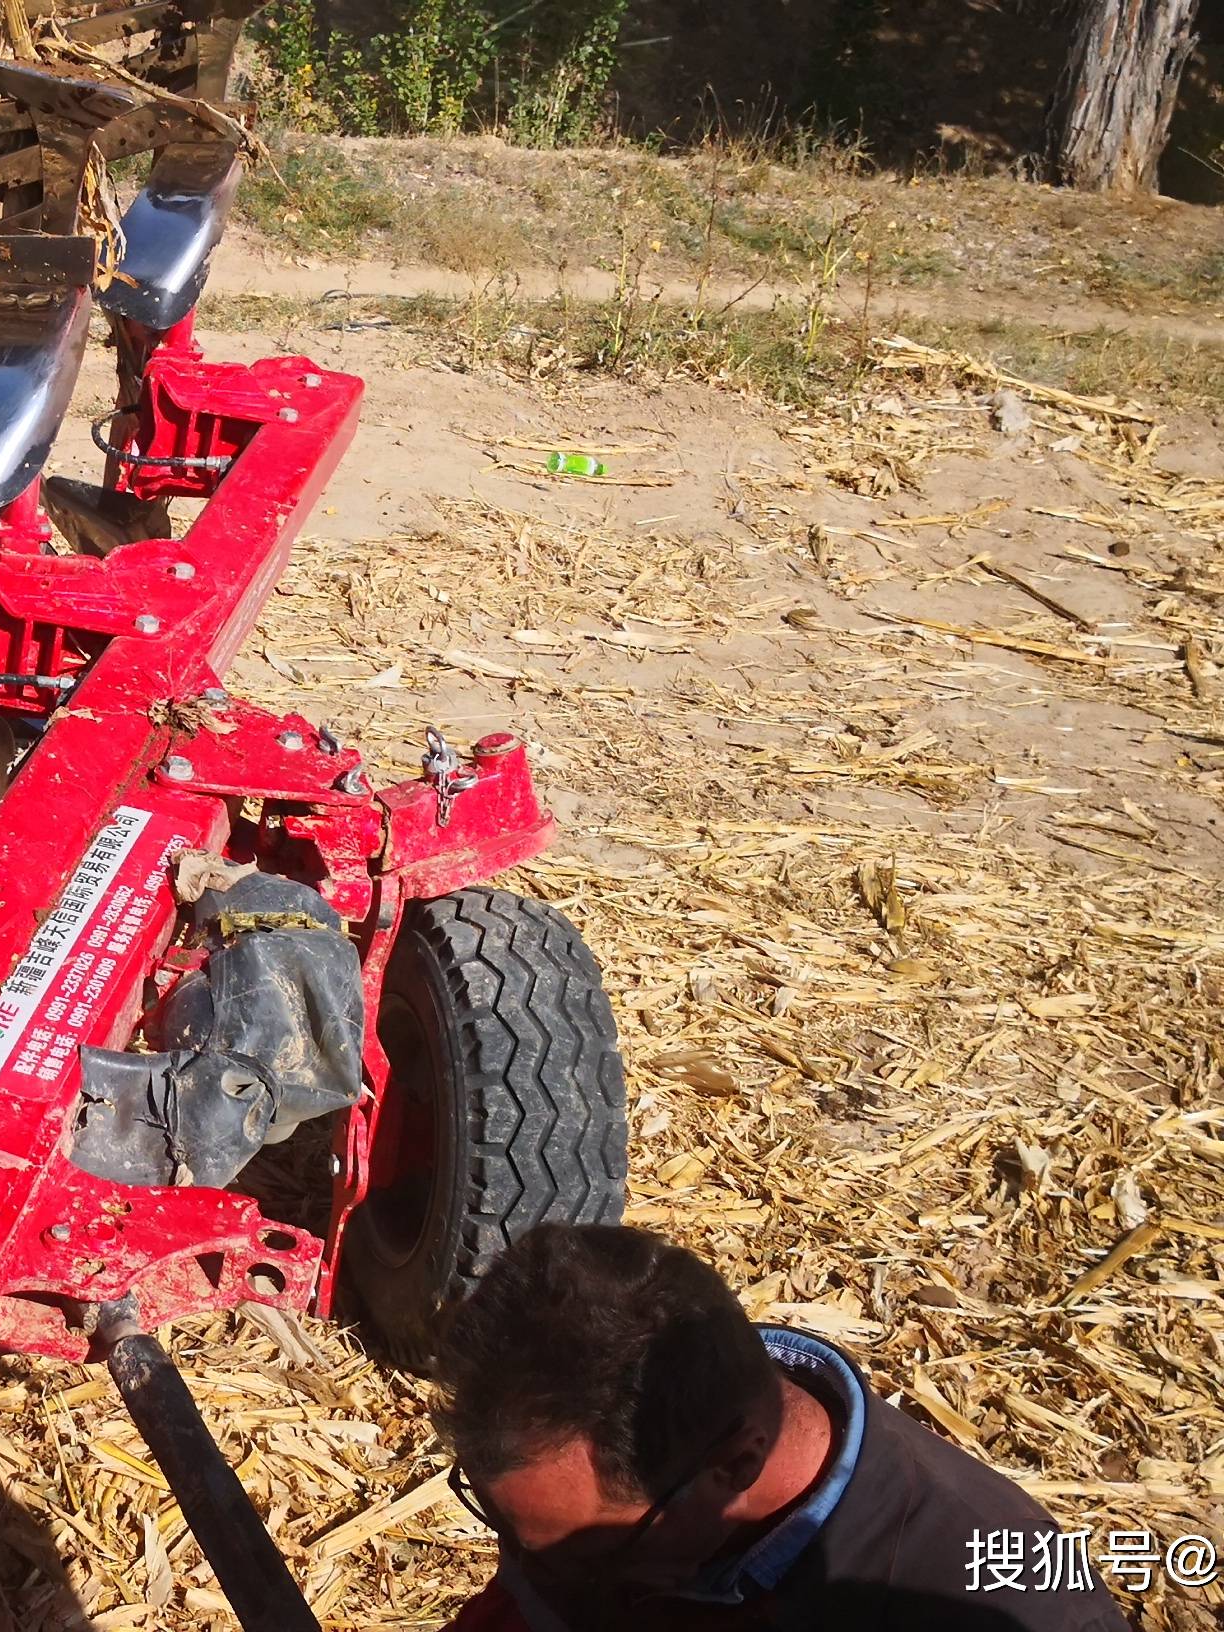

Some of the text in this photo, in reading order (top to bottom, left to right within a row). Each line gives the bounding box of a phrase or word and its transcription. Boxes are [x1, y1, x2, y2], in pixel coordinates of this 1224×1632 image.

[44, 952, 95, 1023] 0991-2337026
[87, 885, 135, 948] 0991-2830662
[67, 957, 117, 1028] 0991-2301609
